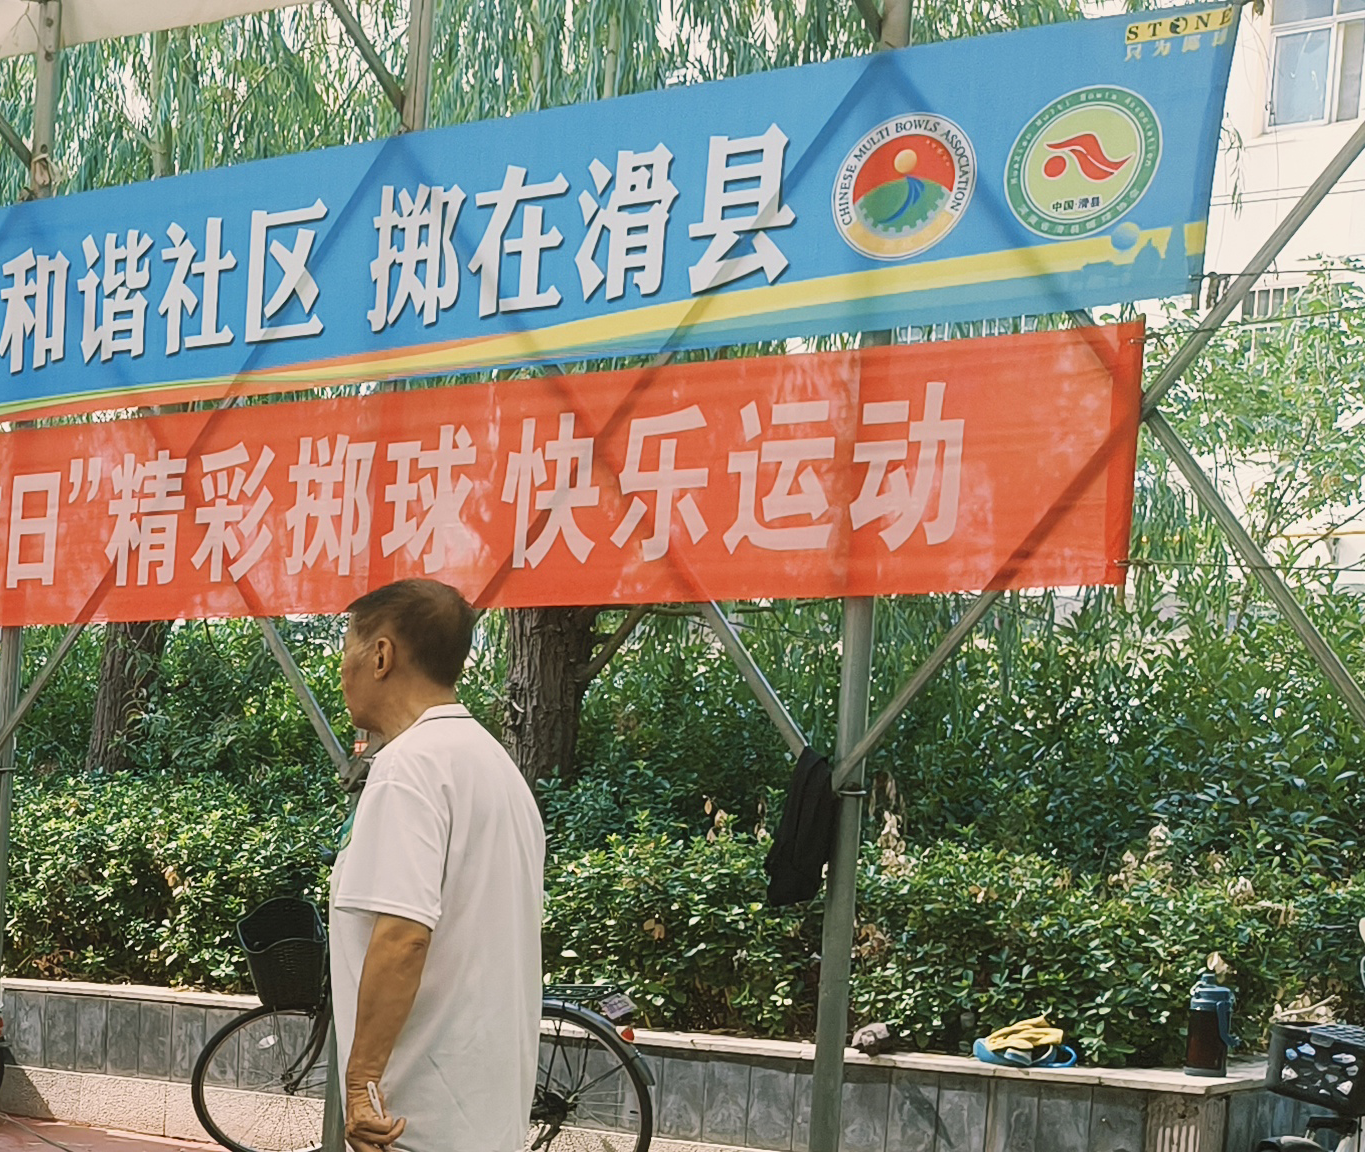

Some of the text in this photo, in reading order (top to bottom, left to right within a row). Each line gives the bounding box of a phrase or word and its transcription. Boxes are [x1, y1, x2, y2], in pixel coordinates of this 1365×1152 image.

[1127, 7, 1232, 41] STONE
[838, 119, 971, 226] CHINESE MULTI BOWLS ASSOCIATION
[367, 122, 797, 333] 掷在滑县
